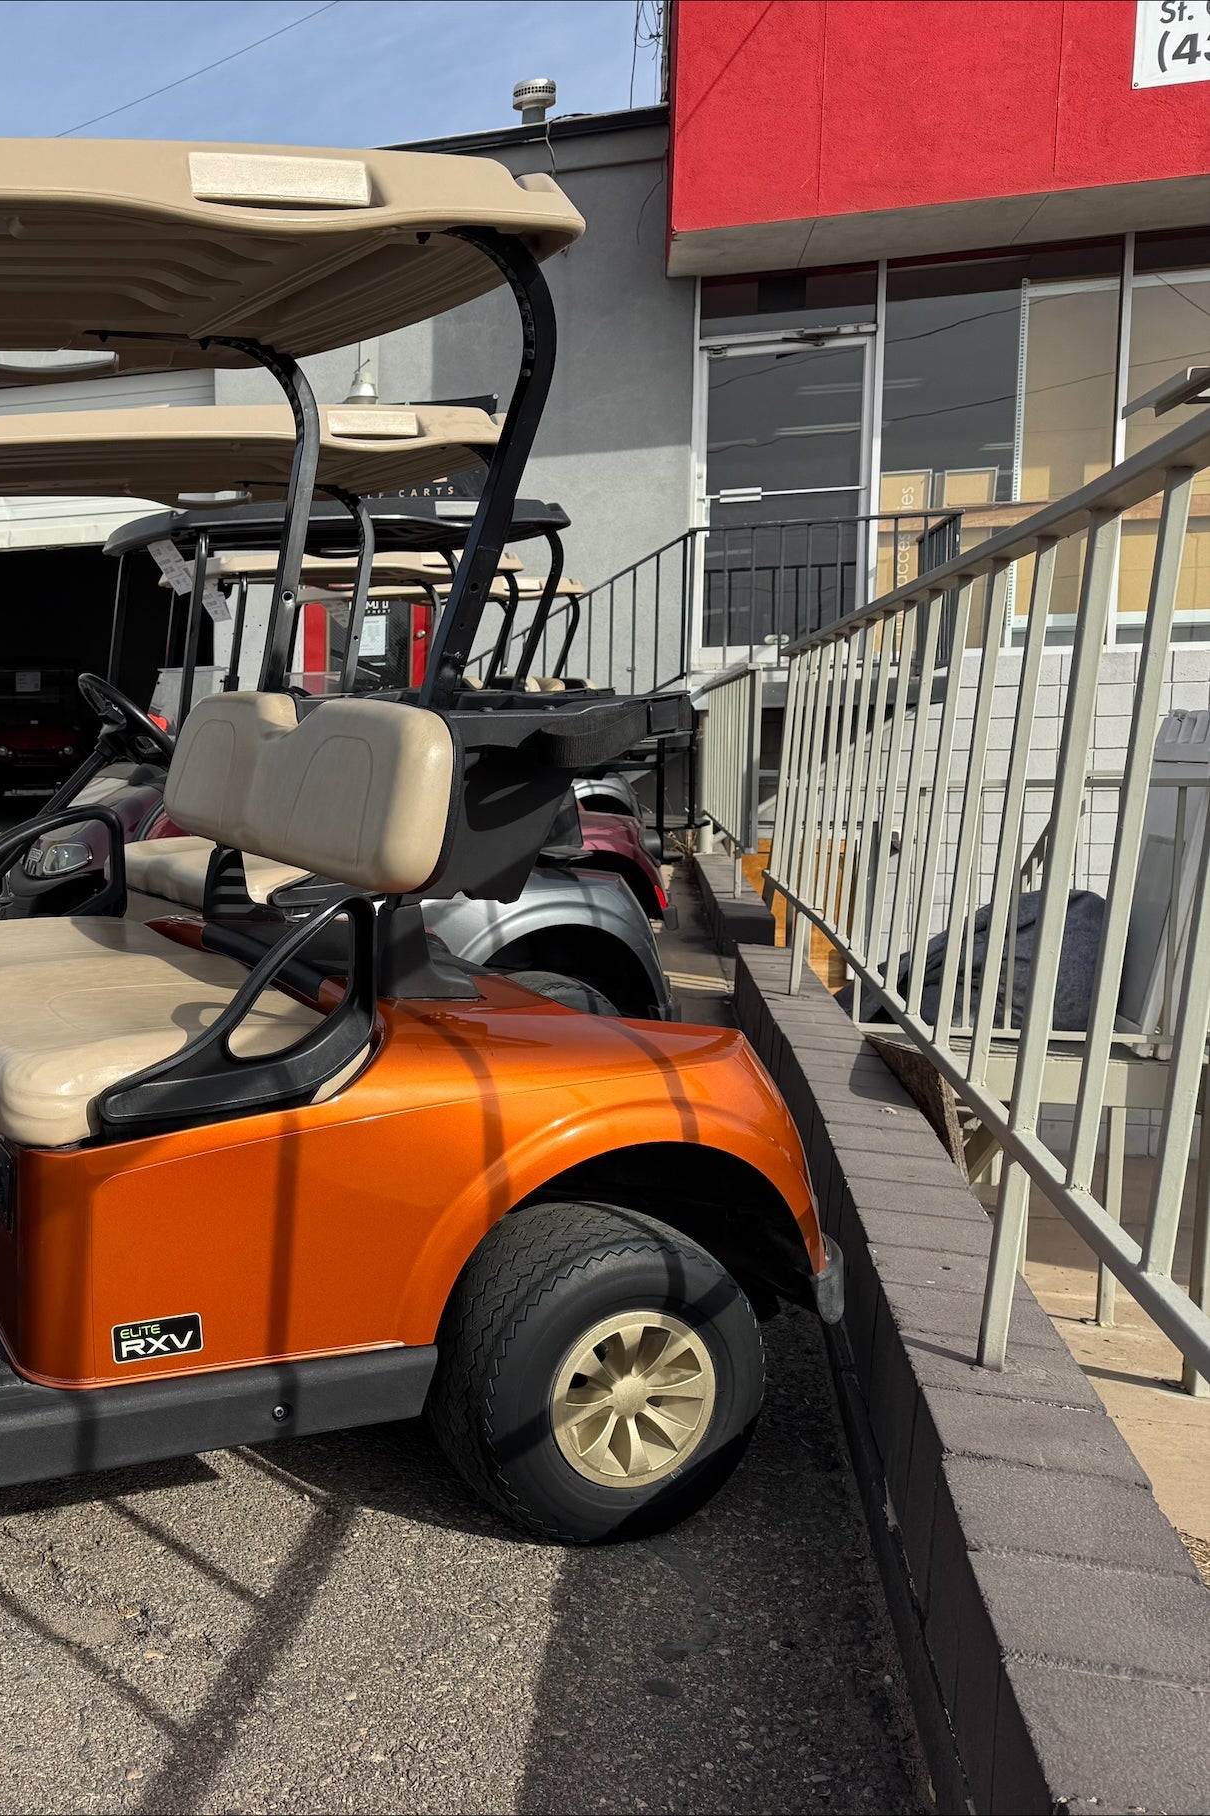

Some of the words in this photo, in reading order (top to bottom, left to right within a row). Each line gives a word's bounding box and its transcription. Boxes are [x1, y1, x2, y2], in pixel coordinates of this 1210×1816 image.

[1160, 0, 1194, 24] St.
[1158, 30, 1210, 73] (4
[398, 486, 454, 498] CARTS
[121, 1330, 194, 1358] RXV
